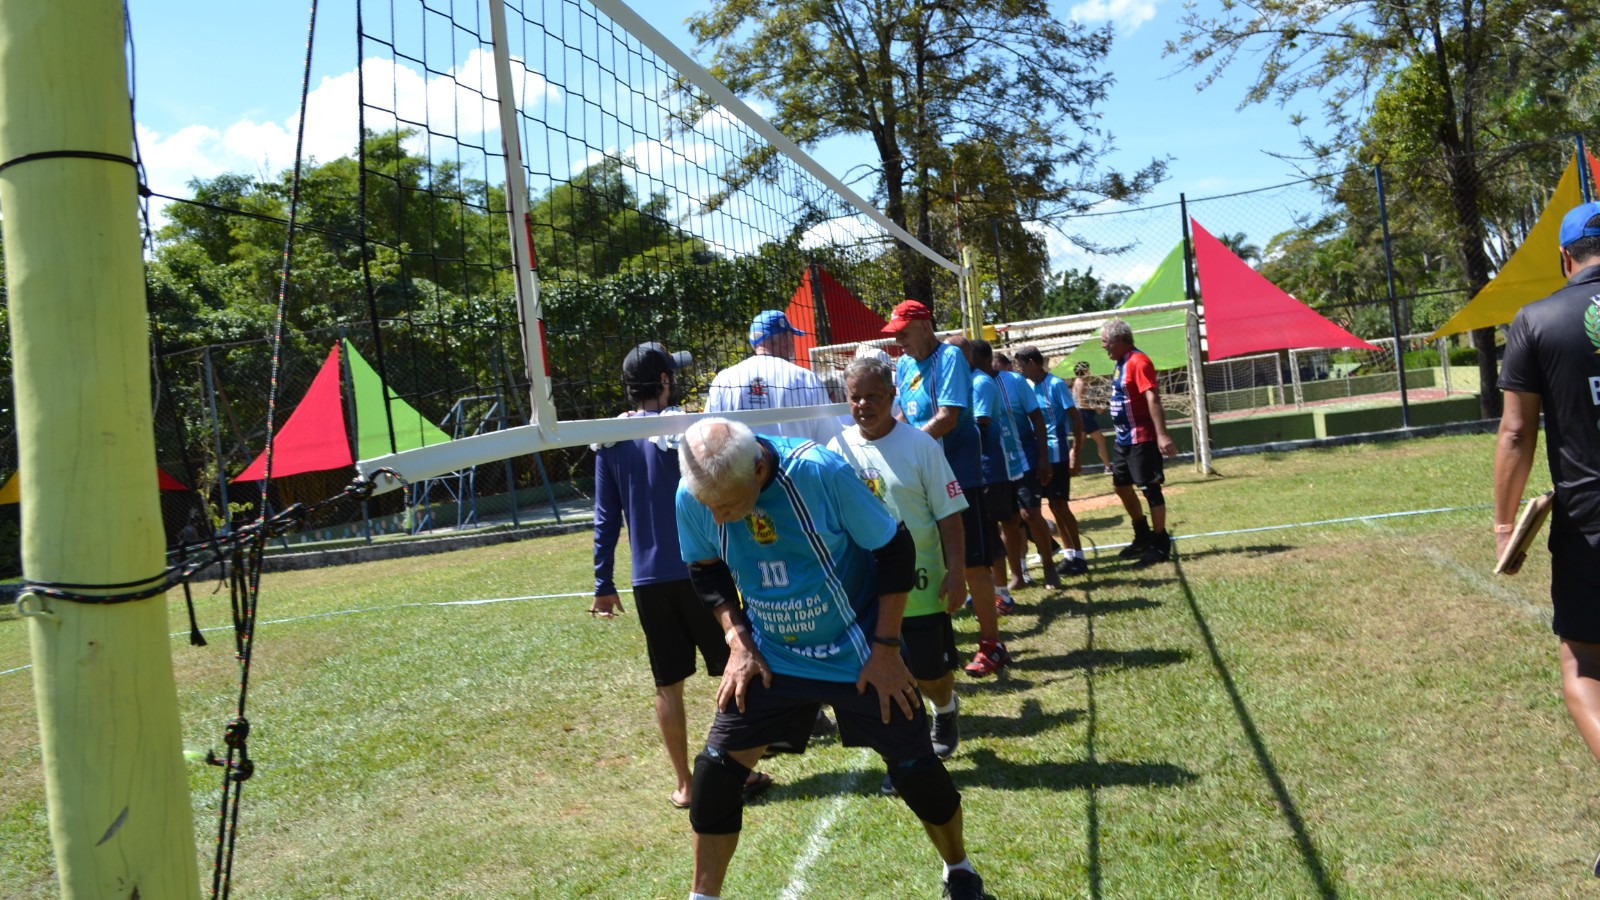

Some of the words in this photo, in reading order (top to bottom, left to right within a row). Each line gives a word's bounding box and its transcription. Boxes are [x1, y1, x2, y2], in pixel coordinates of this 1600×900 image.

[757, 560, 790, 588] 10
[805, 594, 822, 607] DA
[794, 601, 829, 621] IDADE
[763, 621, 776, 634] DE
[777, 620, 816, 634] BAURU
